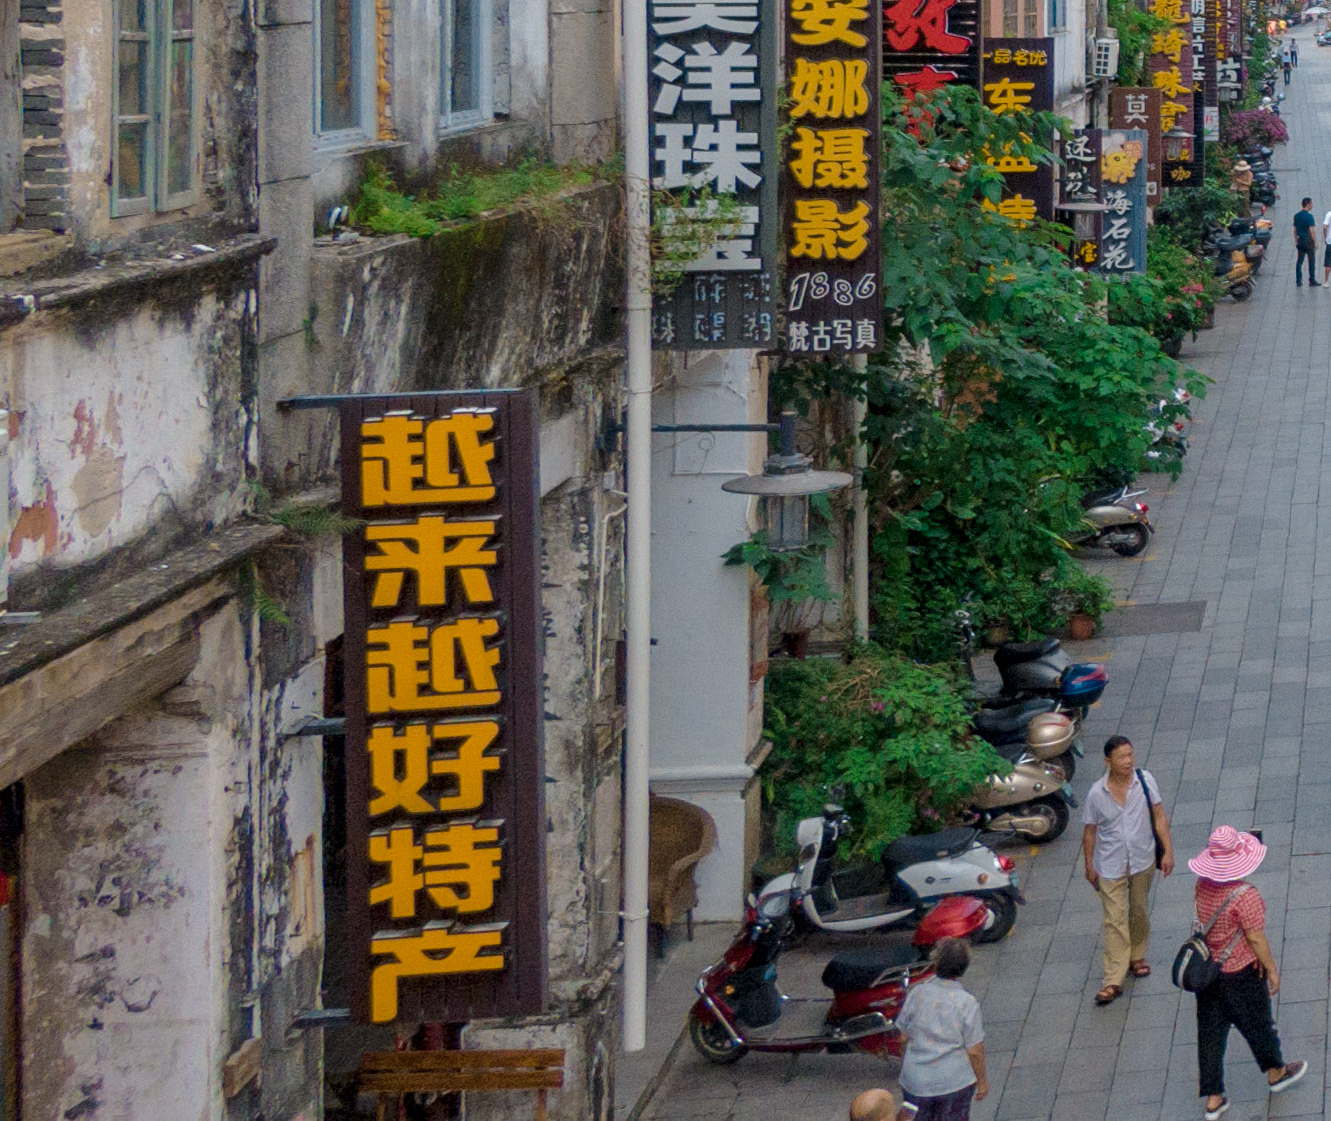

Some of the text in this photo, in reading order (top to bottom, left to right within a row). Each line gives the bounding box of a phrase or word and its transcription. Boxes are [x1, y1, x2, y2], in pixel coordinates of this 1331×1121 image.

[789, 272, 876, 312] 1886
[361, 408, 504, 1023] 越来越好特产
